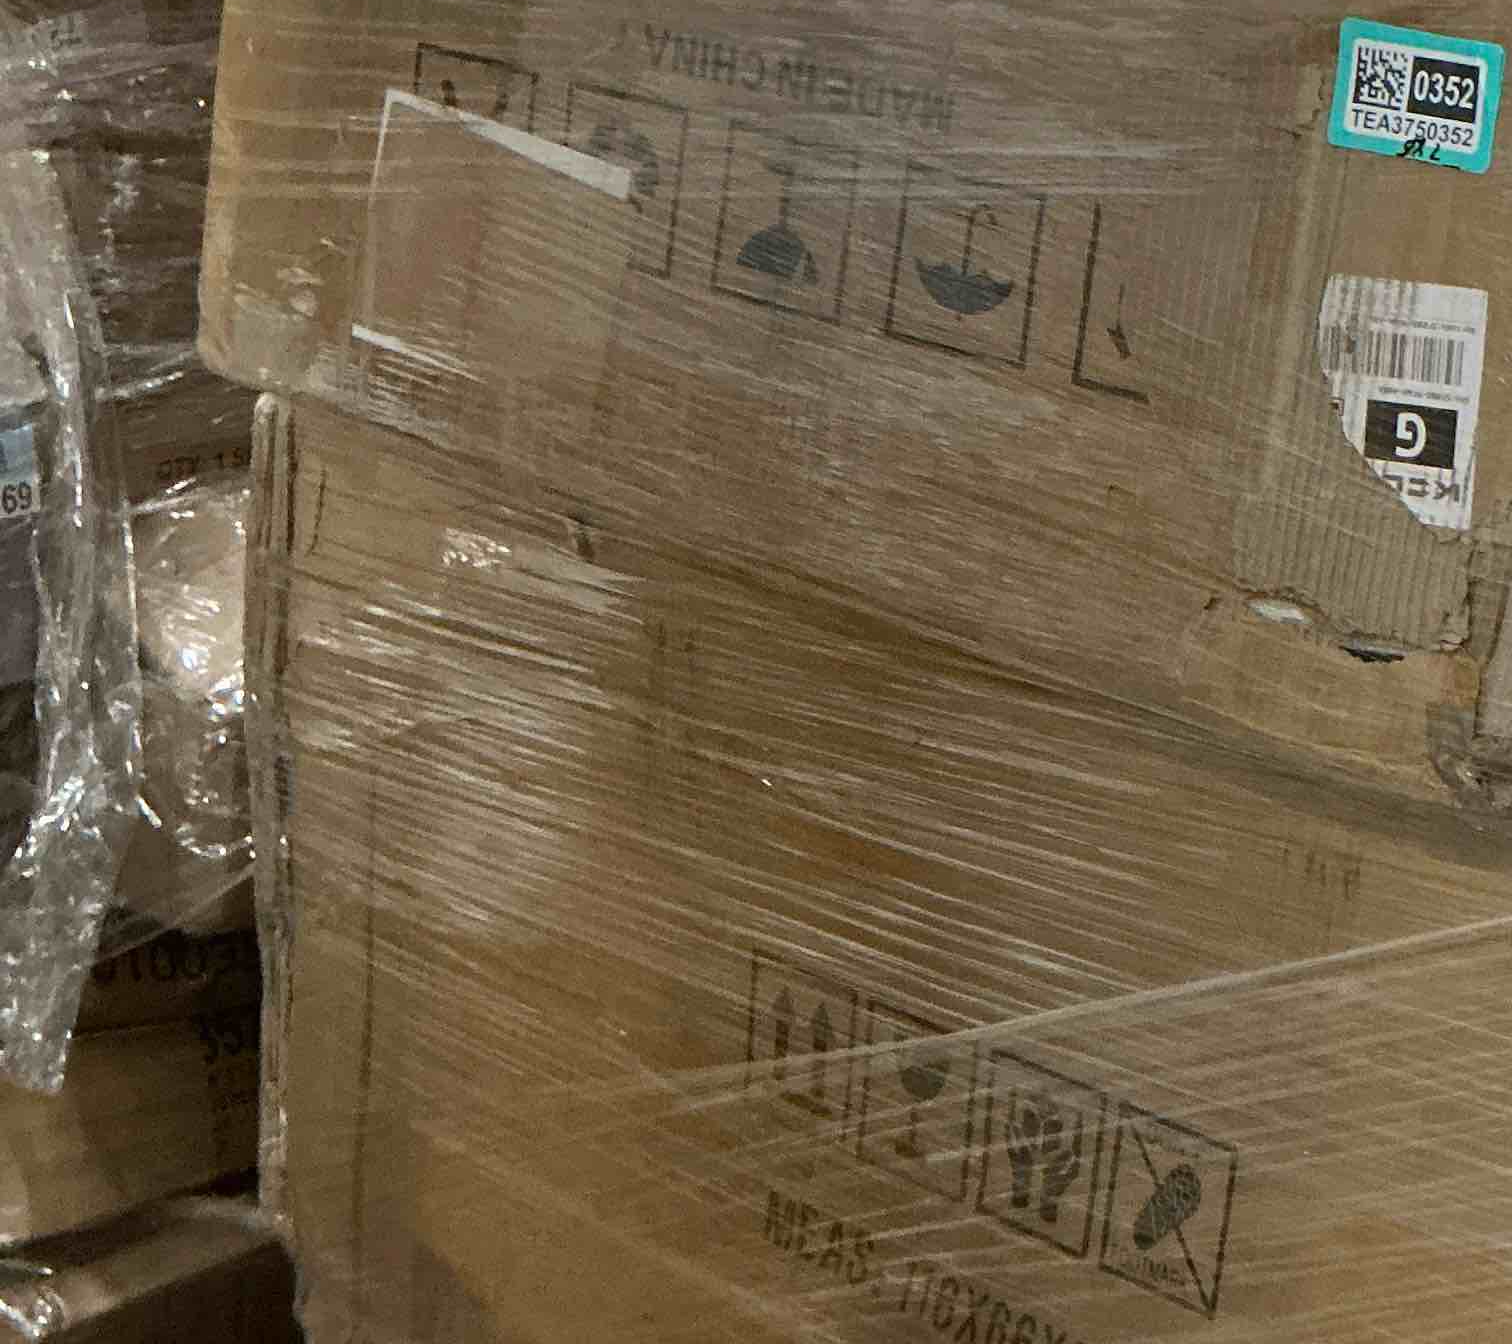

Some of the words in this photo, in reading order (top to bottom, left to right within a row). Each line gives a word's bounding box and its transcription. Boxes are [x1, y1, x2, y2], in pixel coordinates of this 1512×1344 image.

[1413, 69, 1475, 110] 0352
[1351, 108, 1475, 147] TEA3750352
[1394, 411, 1428, 458] G
